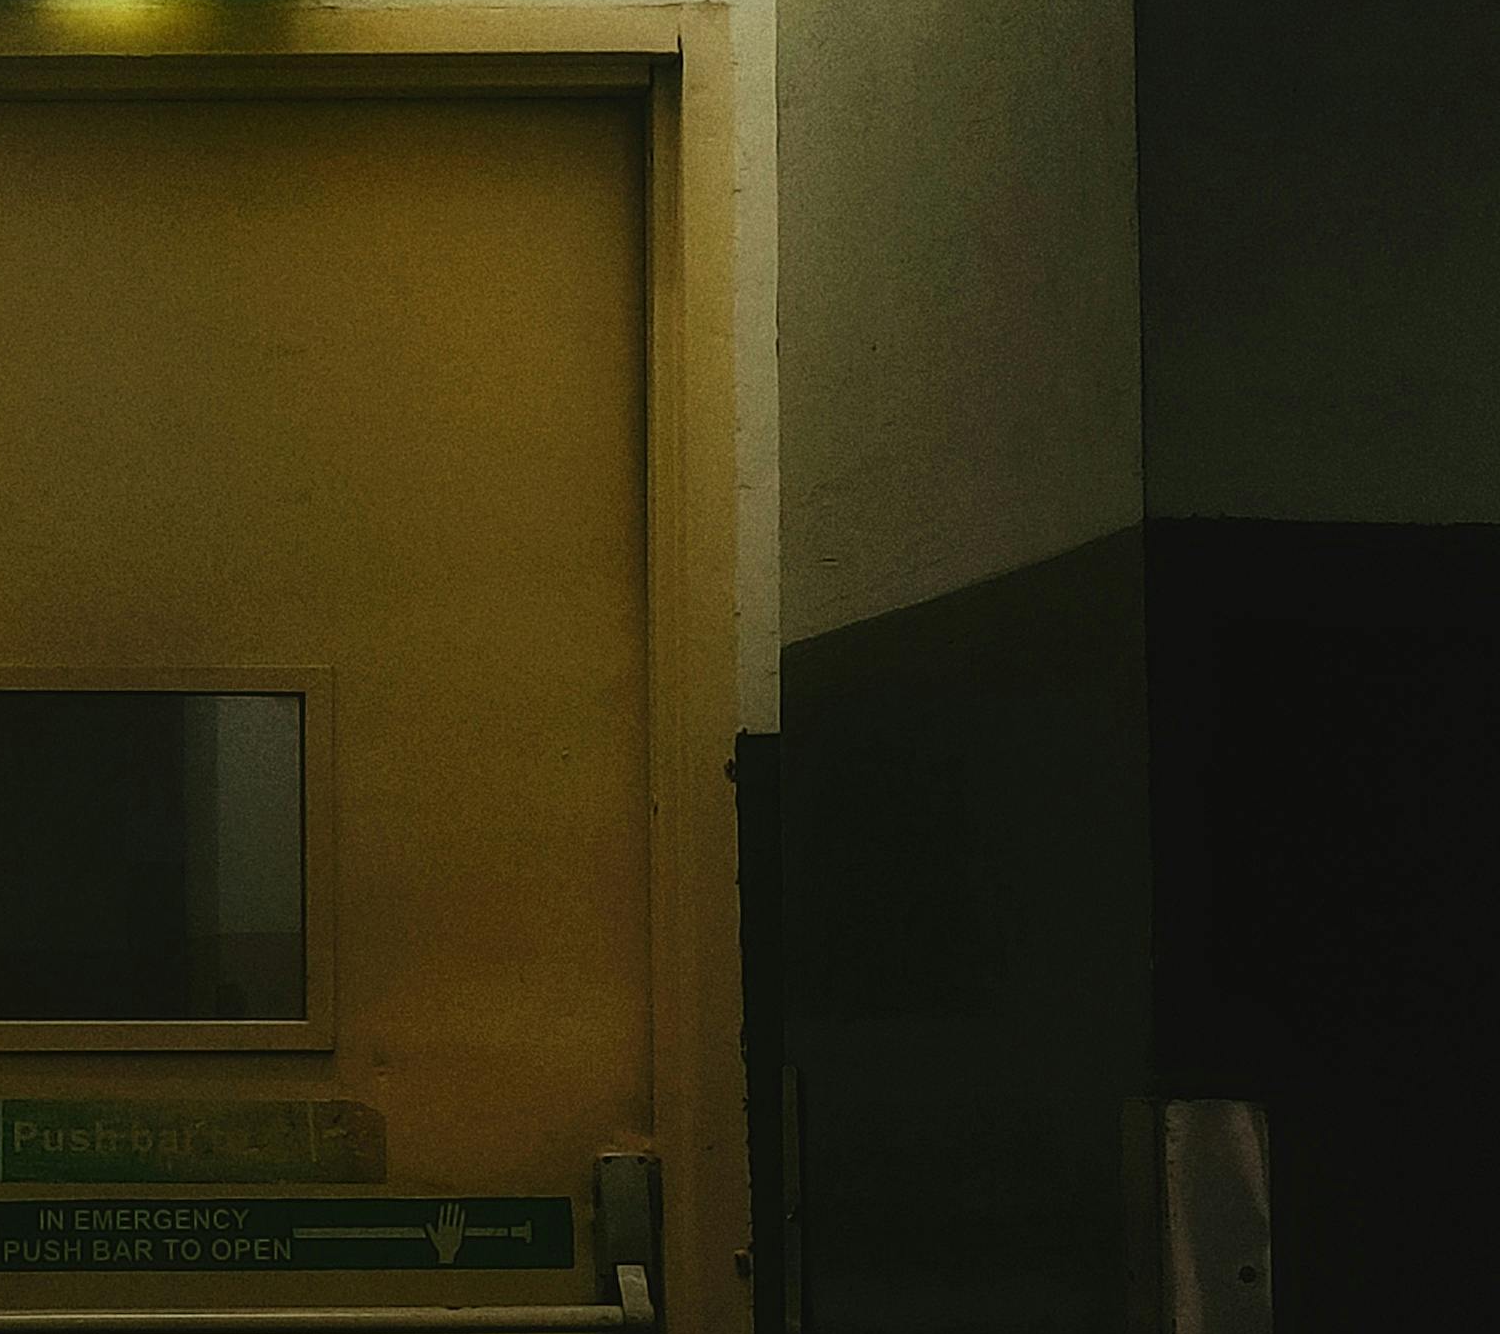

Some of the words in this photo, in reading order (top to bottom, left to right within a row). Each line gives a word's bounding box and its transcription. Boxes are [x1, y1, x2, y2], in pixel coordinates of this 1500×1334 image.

[13, 1120, 118, 1154] Push
[38, 1209, 65, 1231] IN
[74, 1208, 250, 1231] EMERGENCY
[3, 1239, 82, 1262] PUSH
[92, 1238, 153, 1261] BAR
[163, 1238, 201, 1261] TO
[211, 1237, 292, 1261] OPEN
